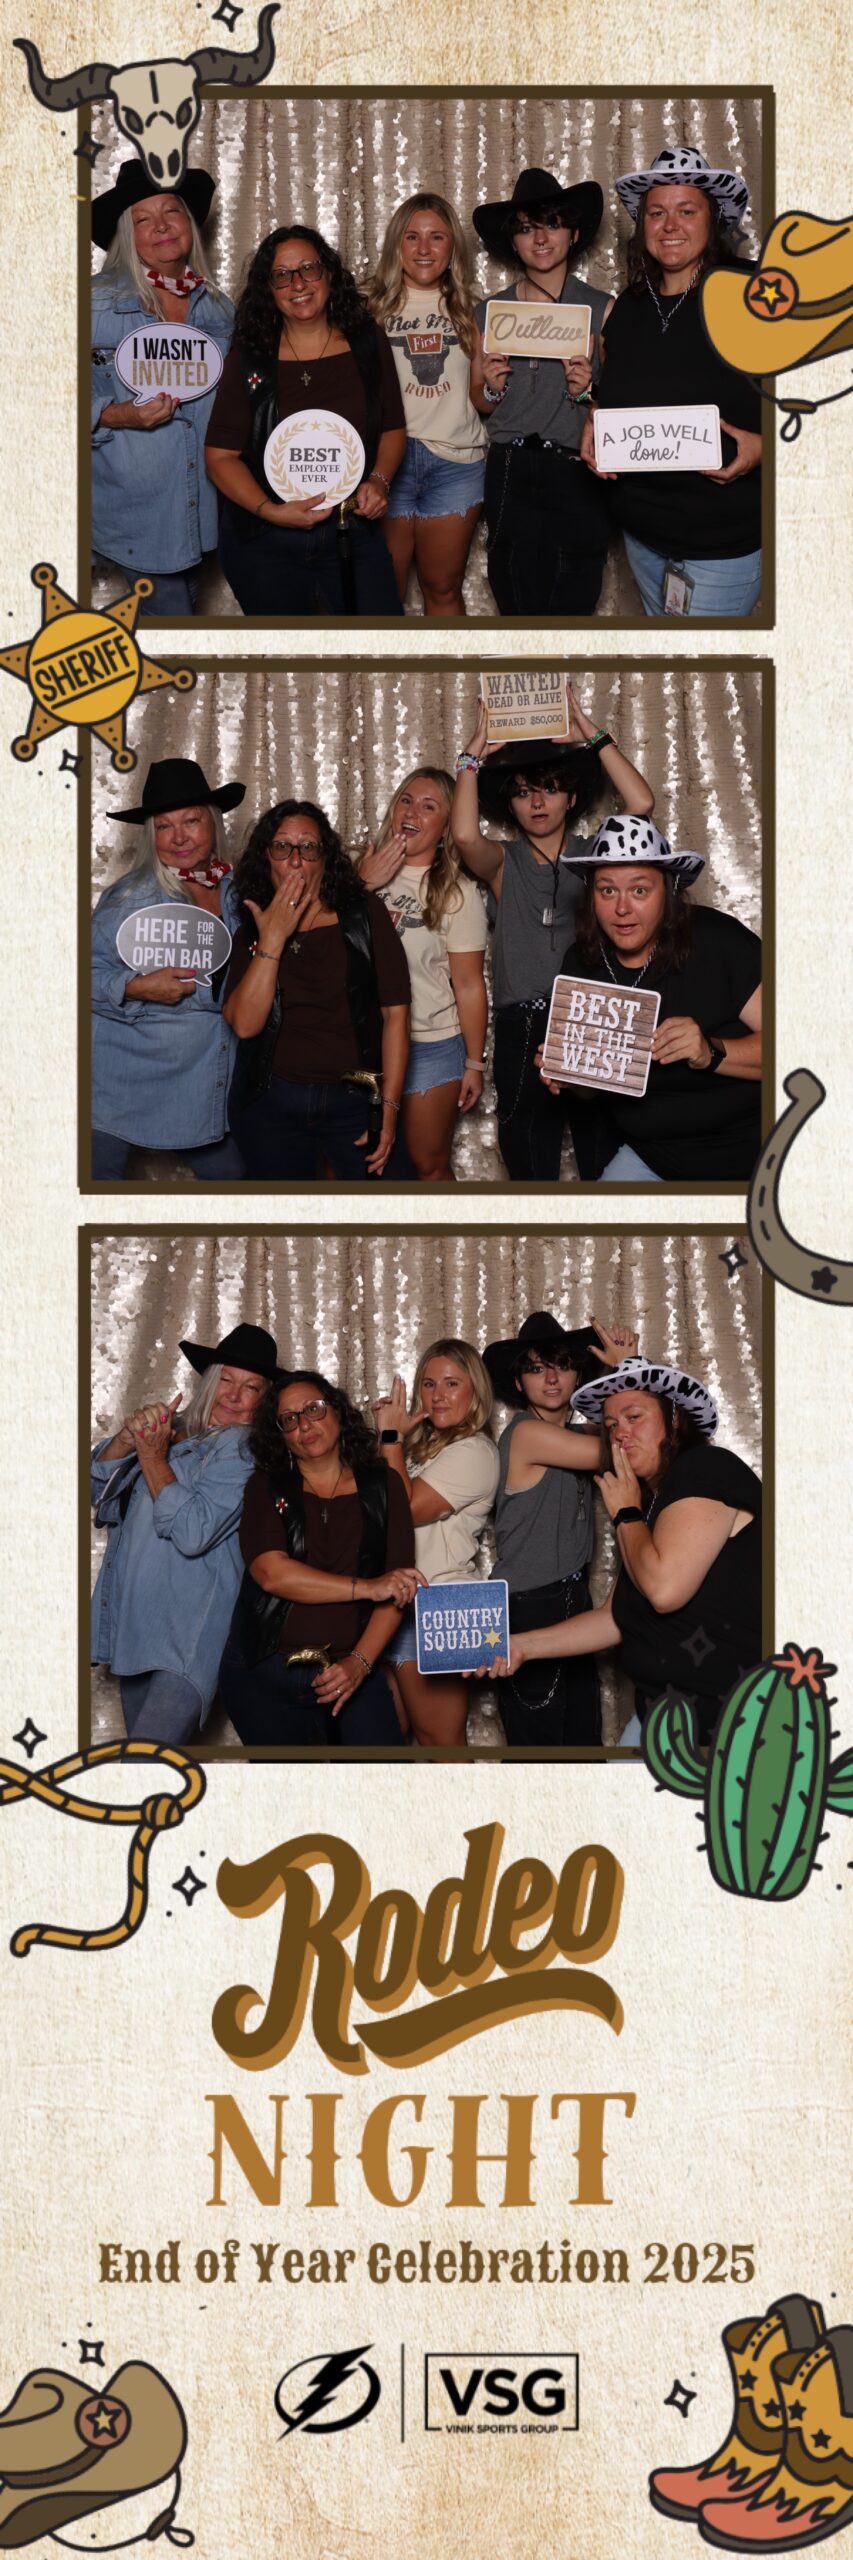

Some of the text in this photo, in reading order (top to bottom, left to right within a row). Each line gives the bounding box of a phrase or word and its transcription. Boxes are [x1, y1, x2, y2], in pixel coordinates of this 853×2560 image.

[384, 314, 420, 333] Not
[490, 313, 586, 341] Outlaw
[133, 337, 207, 361] I WASN'T
[413, 335, 437, 351] First
[132, 360, 208, 387] INVITED
[404, 381, 451, 399] RODEO
[602, 423, 713, 448] A JOB WELL
[289, 447, 341, 463] BEST
[629, 440, 681, 461] done!
[289, 464, 340, 473] EMPLOYEE
[301, 474, 328, 483] EVER
[486, 671, 561, 695] WANTED
[488, 692, 562, 709] DEAD OR ALIVE
[489, 714, 564, 729] REWARD $50,000
[134, 917, 215, 944] HERE FOR
[197, 933, 214, 946] THE
[132, 946, 213, 969] OPEN BAR
[567, 990, 641, 1032] BEST
[563, 1022, 636, 1054] IN THE
[561, 1042, 633, 1083] WEST
[422, 1607, 503, 1631] COUNTRY
[424, 1629, 482, 1652] SQUAD
